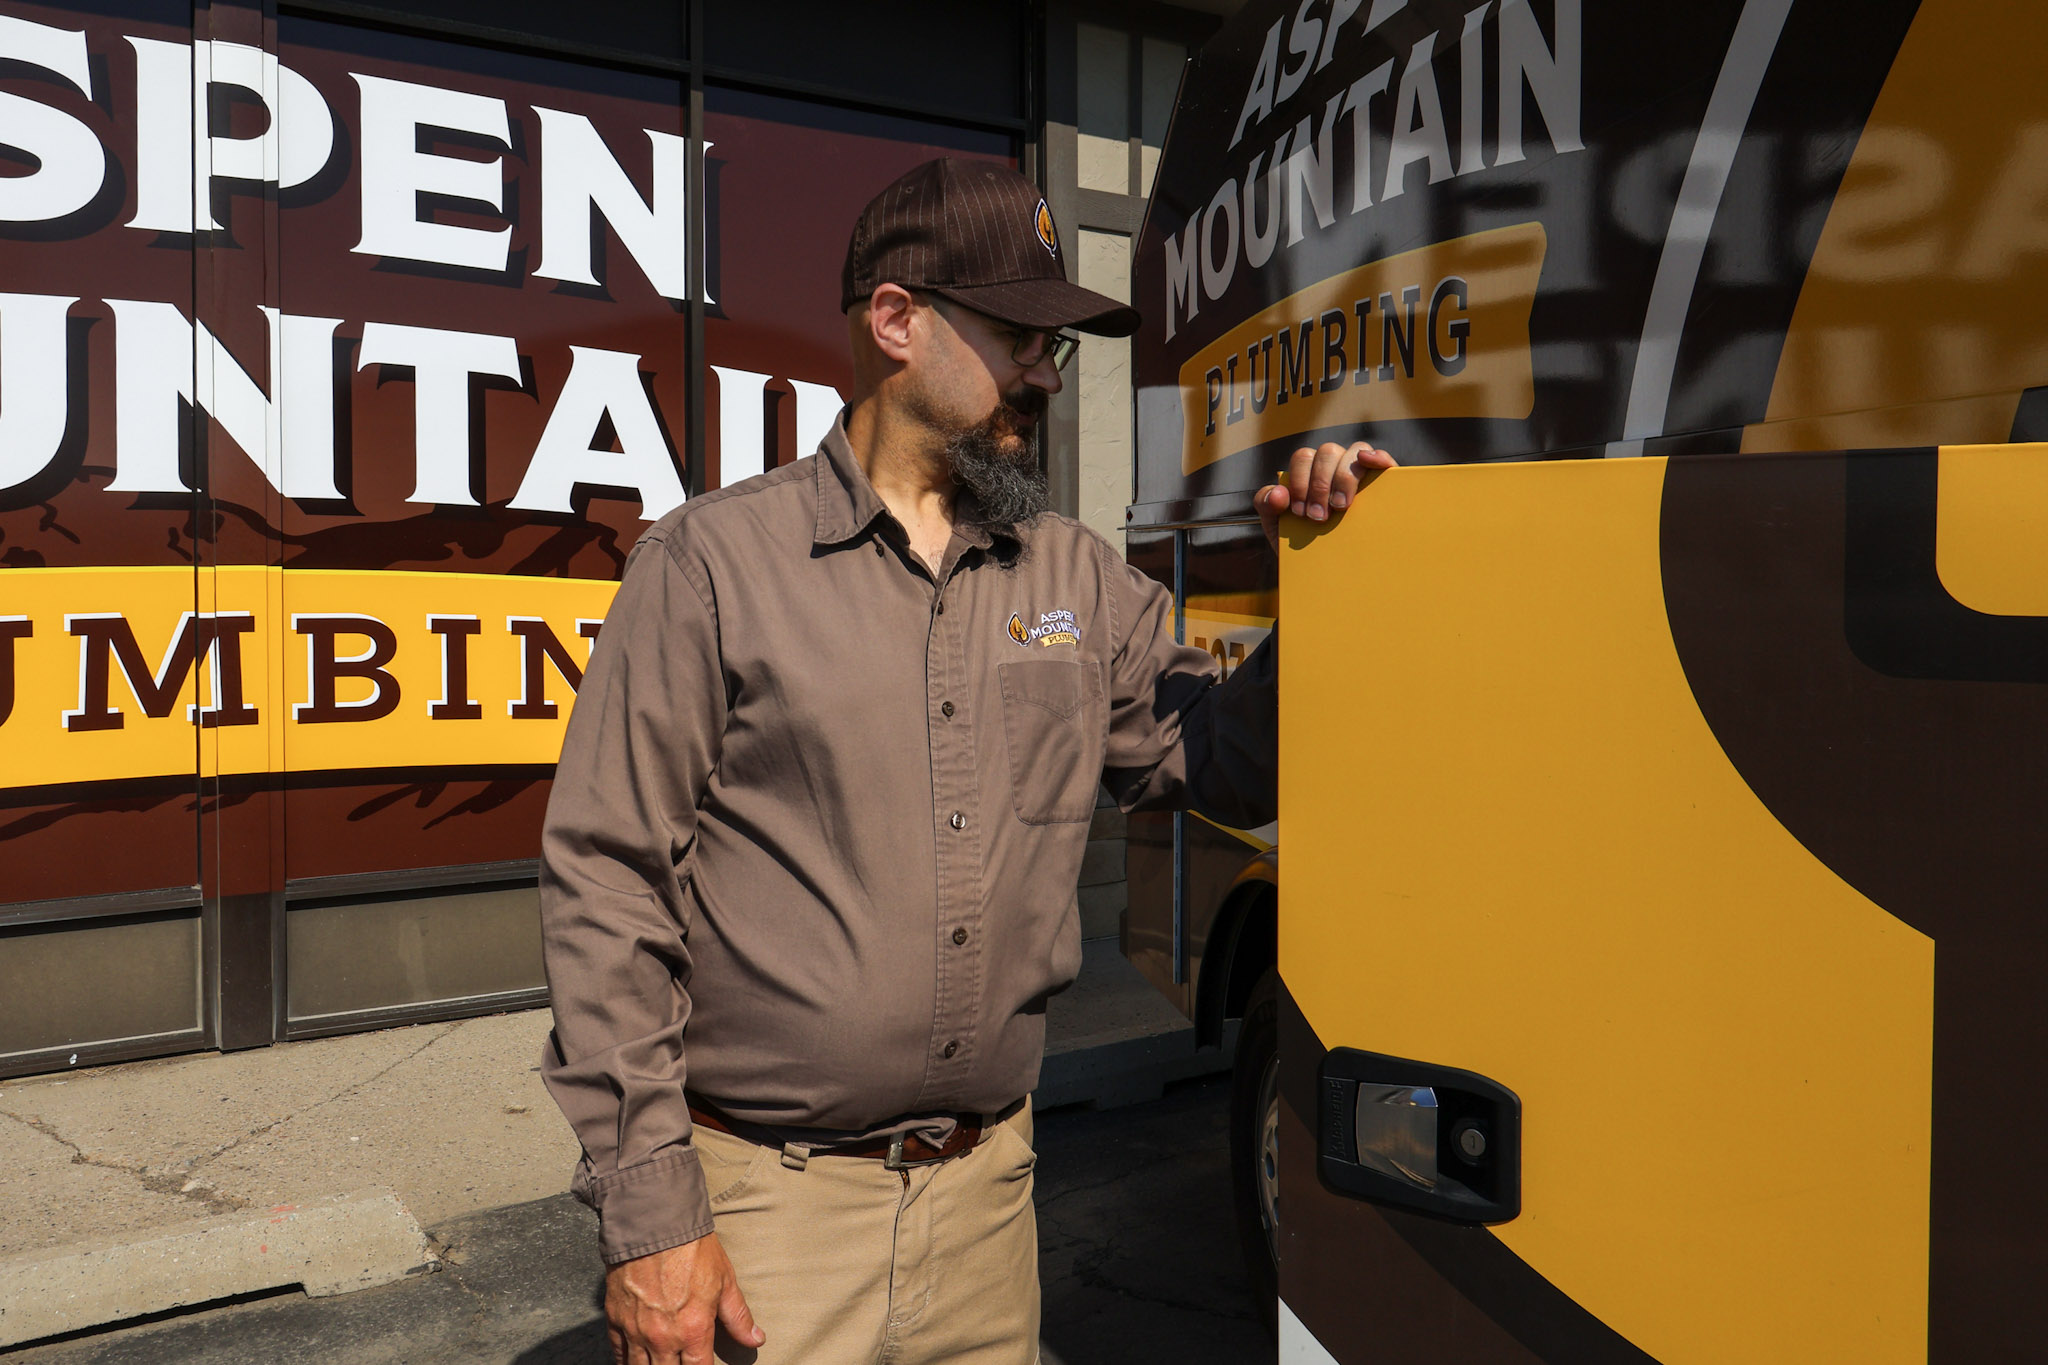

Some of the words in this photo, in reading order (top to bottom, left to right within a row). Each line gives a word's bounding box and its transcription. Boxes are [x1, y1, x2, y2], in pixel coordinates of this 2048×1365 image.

[1228, 0, 1408, 153] ASP
[1164, 0, 1586, 345] MOUNTAIN
[1204, 275, 1470, 437] PLUMBING
[0, 611, 604, 733] MBIN
